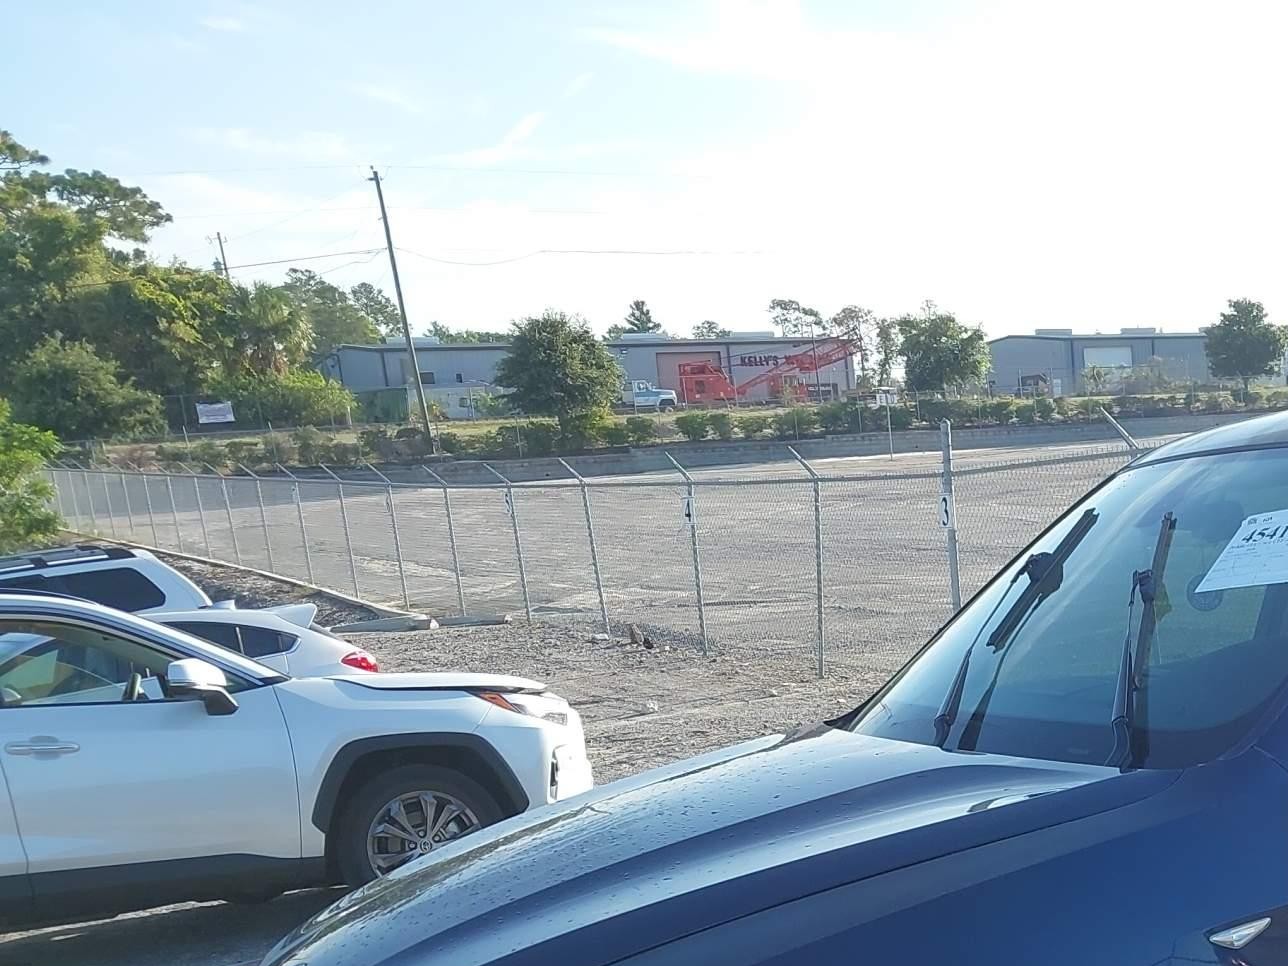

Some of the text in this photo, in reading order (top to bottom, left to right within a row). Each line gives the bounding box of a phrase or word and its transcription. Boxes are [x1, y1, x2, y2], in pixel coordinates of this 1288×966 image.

[740, 354, 779, 367] KELLY'S
[684, 499, 691, 522] 4
[940, 496, 949, 526] 3
